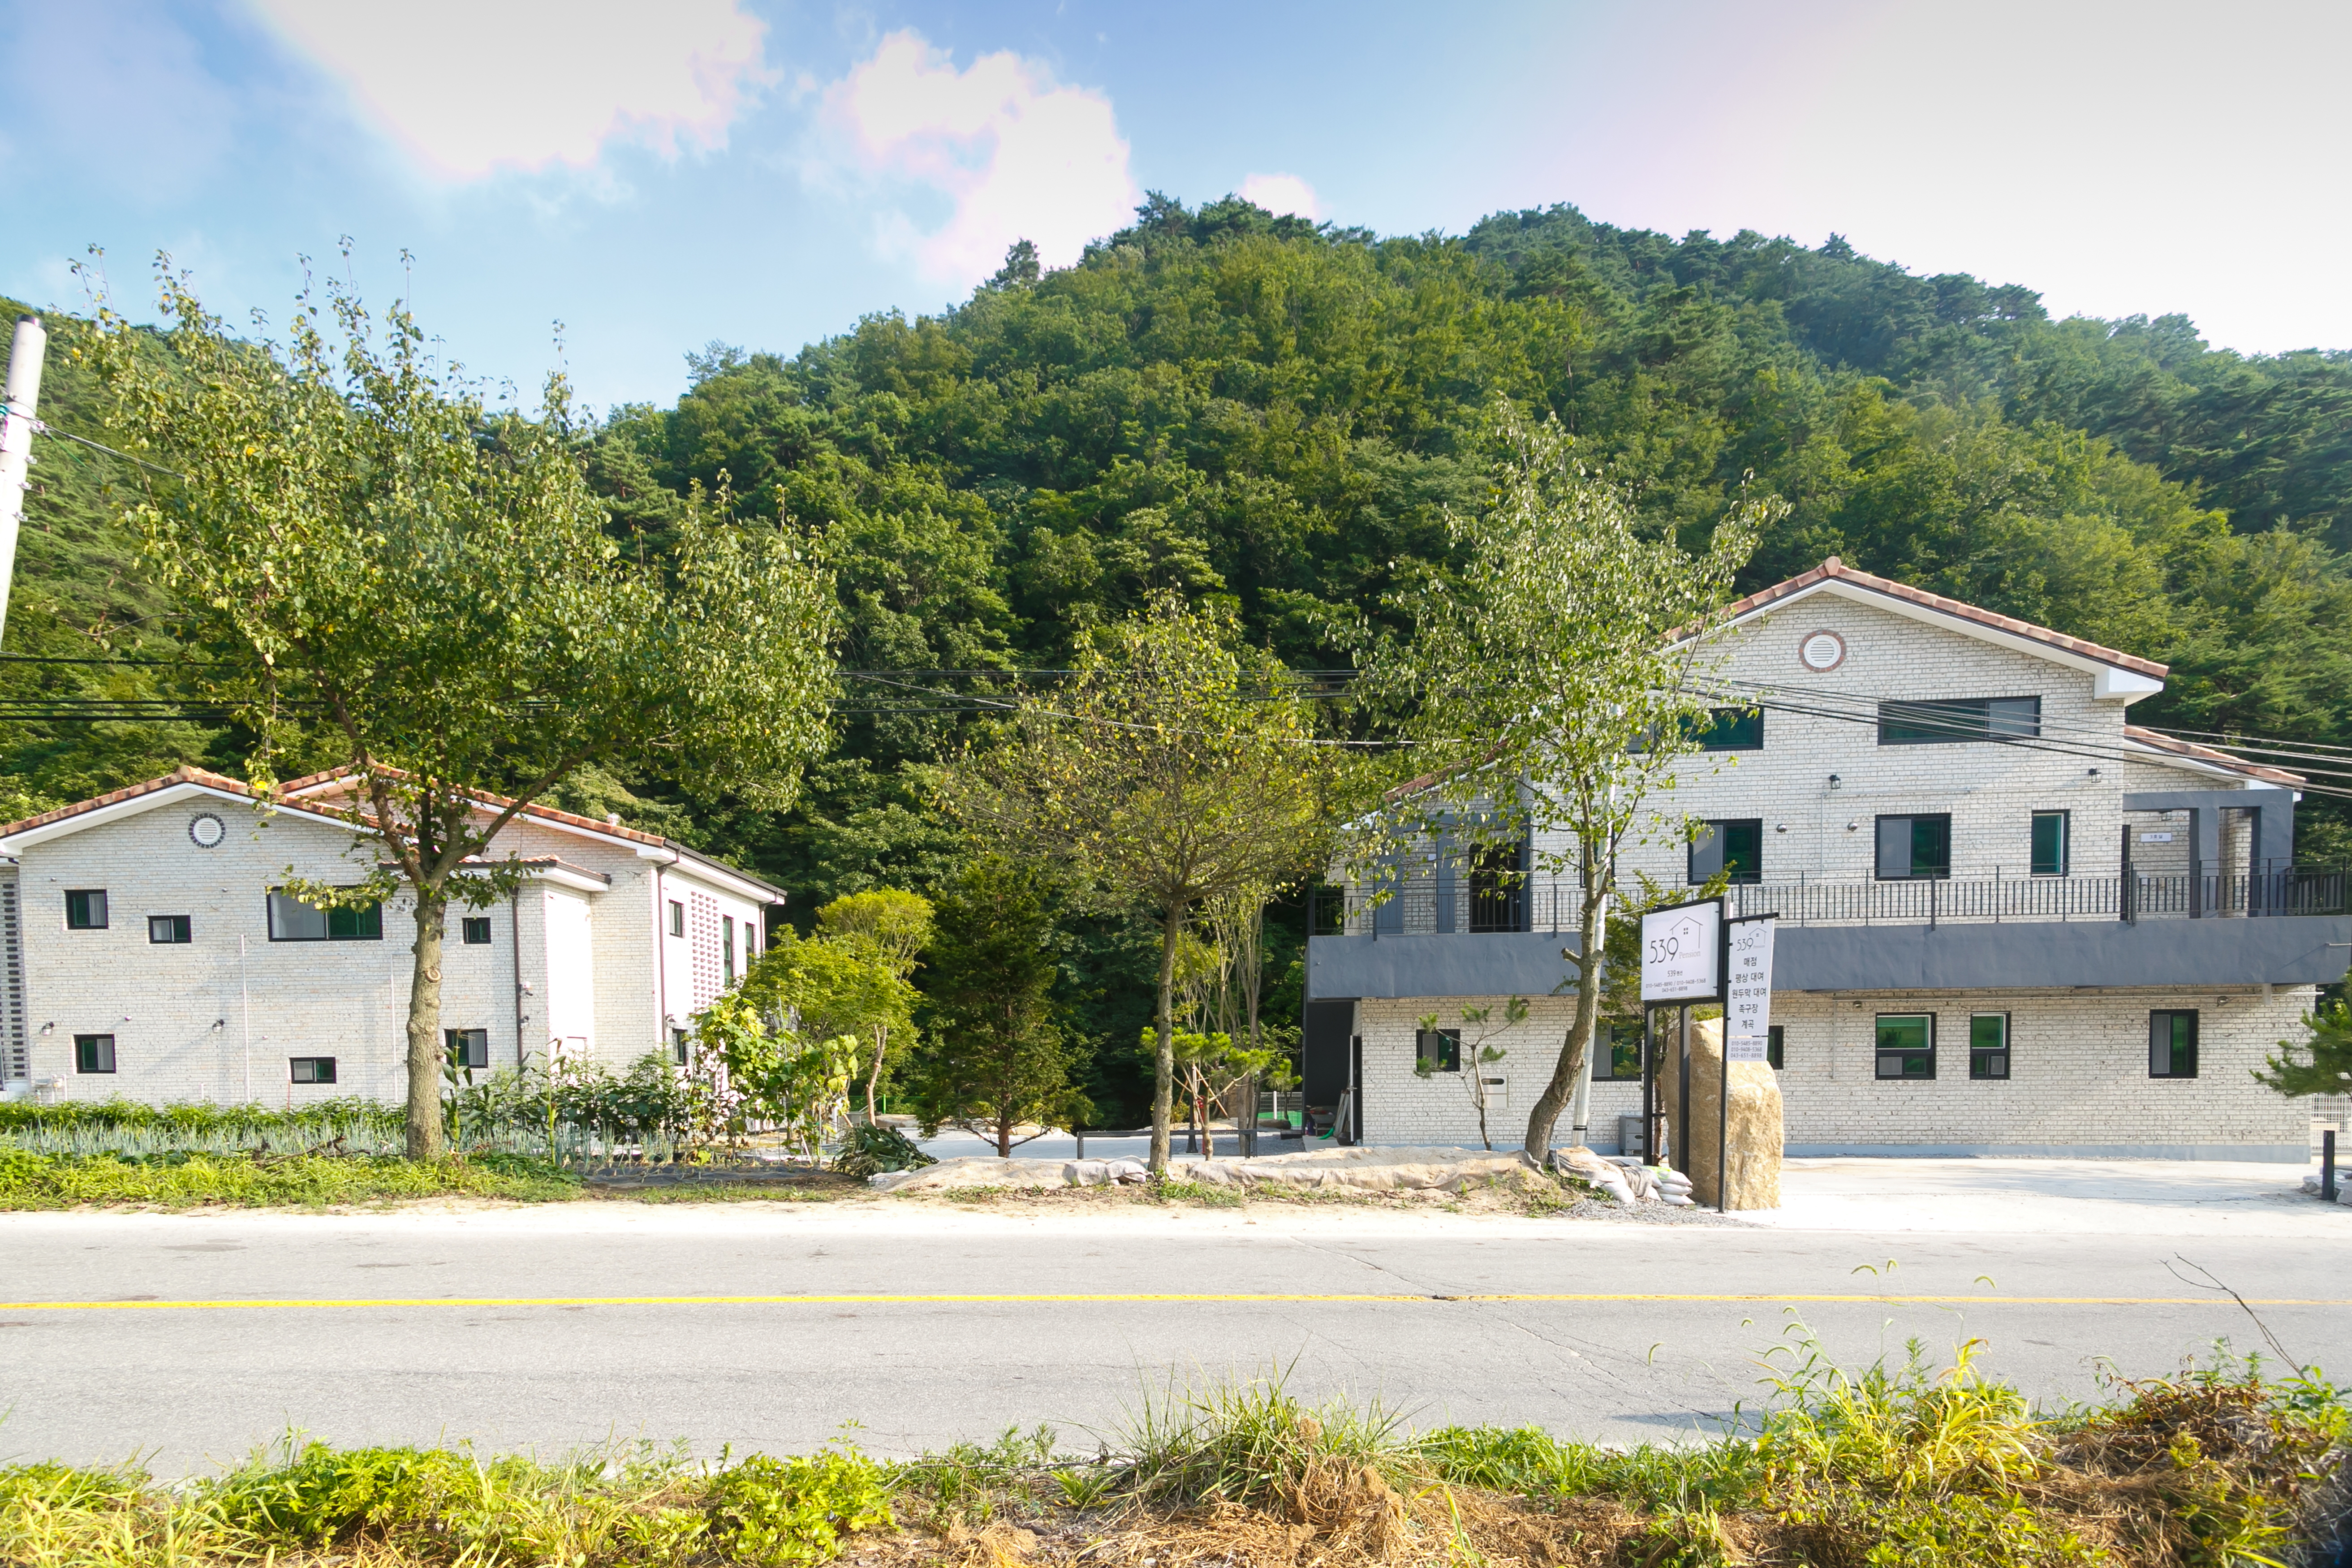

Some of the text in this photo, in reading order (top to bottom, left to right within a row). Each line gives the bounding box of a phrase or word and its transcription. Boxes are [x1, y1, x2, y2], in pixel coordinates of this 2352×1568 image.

[1736, 937, 1753, 951] 539
[1650, 937, 1679, 964] 539
[1679, 950, 1701, 959] Pension
[1744, 956, 1757, 967] 매점
[1735, 971, 1764, 983] 평상 대여
[1732, 987, 1766, 999] 원두막 대여
[1739, 1004, 1758, 1014] 족구장
[1741, 1020, 1754, 1029] 계곡
